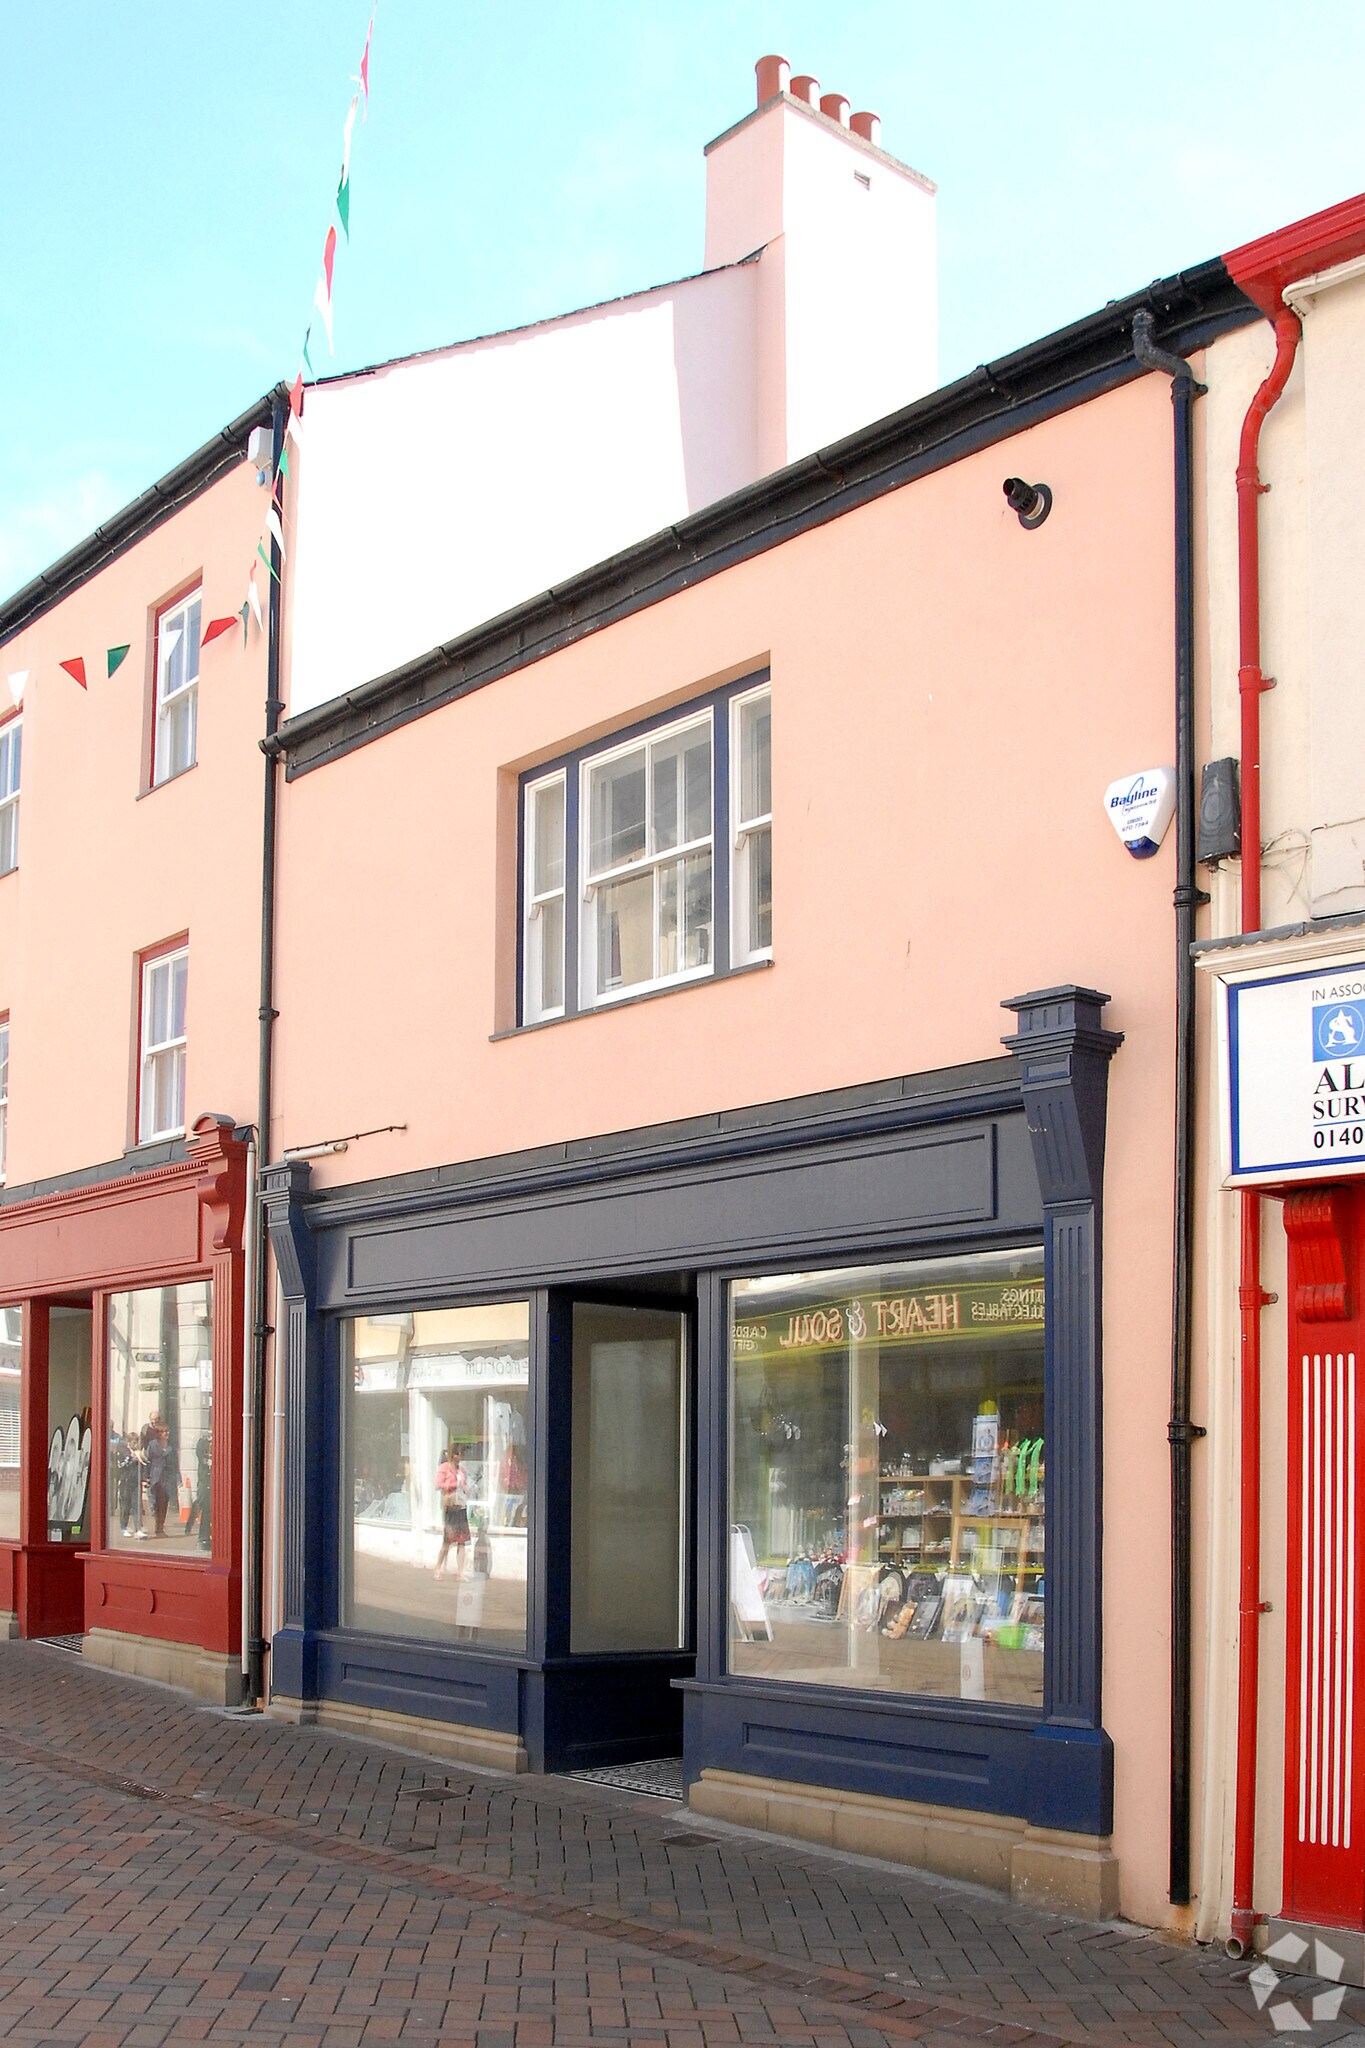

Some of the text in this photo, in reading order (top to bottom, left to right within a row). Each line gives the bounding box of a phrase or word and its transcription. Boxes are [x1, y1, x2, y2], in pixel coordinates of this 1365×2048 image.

[1110, 787, 1158, 808] Bayline
[1311, 982, 1365, 1001] IN ASSO
[1313, 1126, 1364, 1149] 0140
